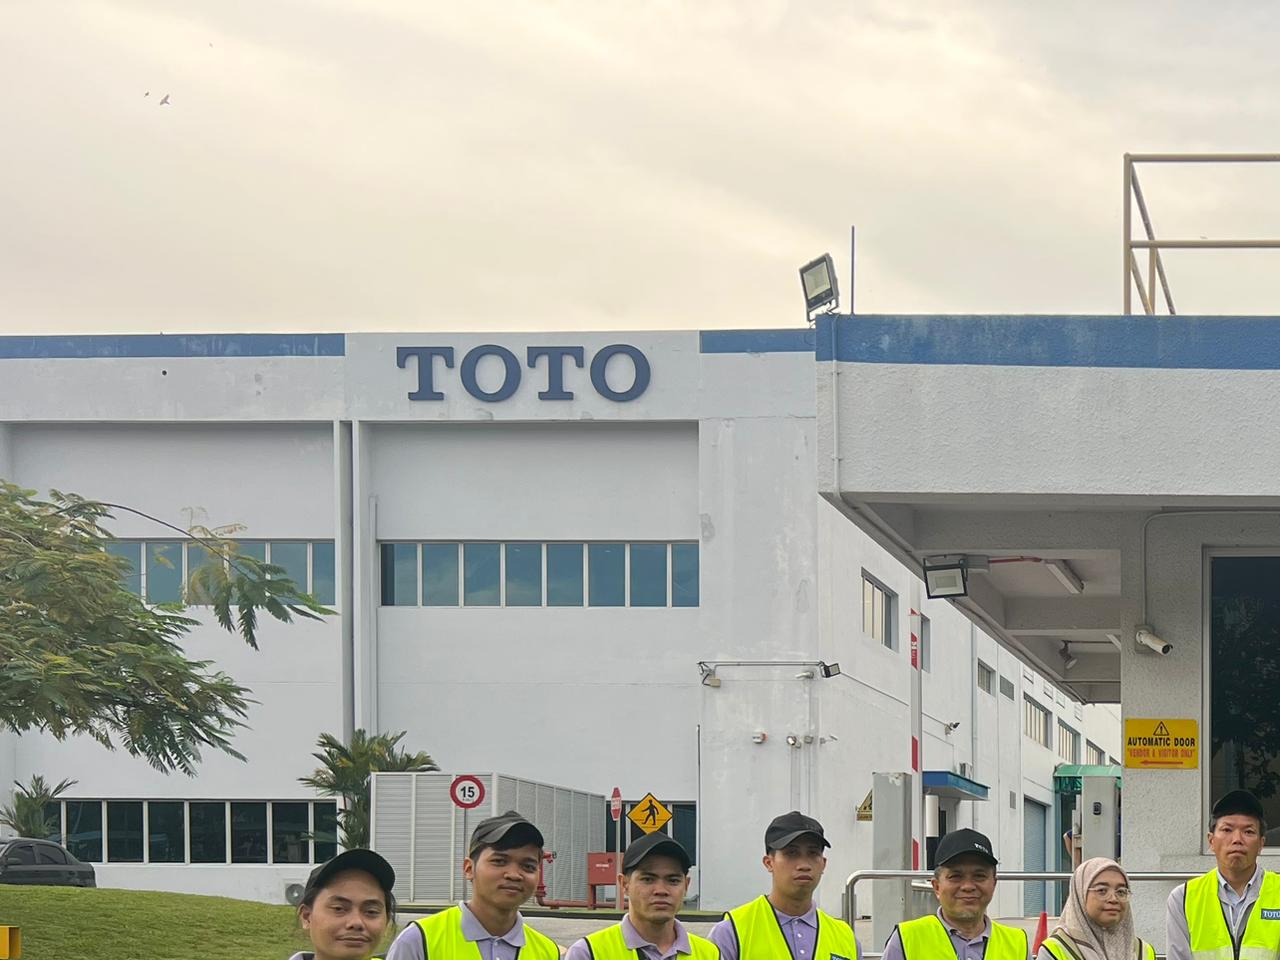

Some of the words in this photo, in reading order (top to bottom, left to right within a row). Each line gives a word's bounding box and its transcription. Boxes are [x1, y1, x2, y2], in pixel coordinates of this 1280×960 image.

[396, 344, 652, 402] TOTO
[1128, 737, 1171, 746] AUTOMATIC
[1174, 737, 1196, 747] DOOR
[460, 786, 475, 798] 15
